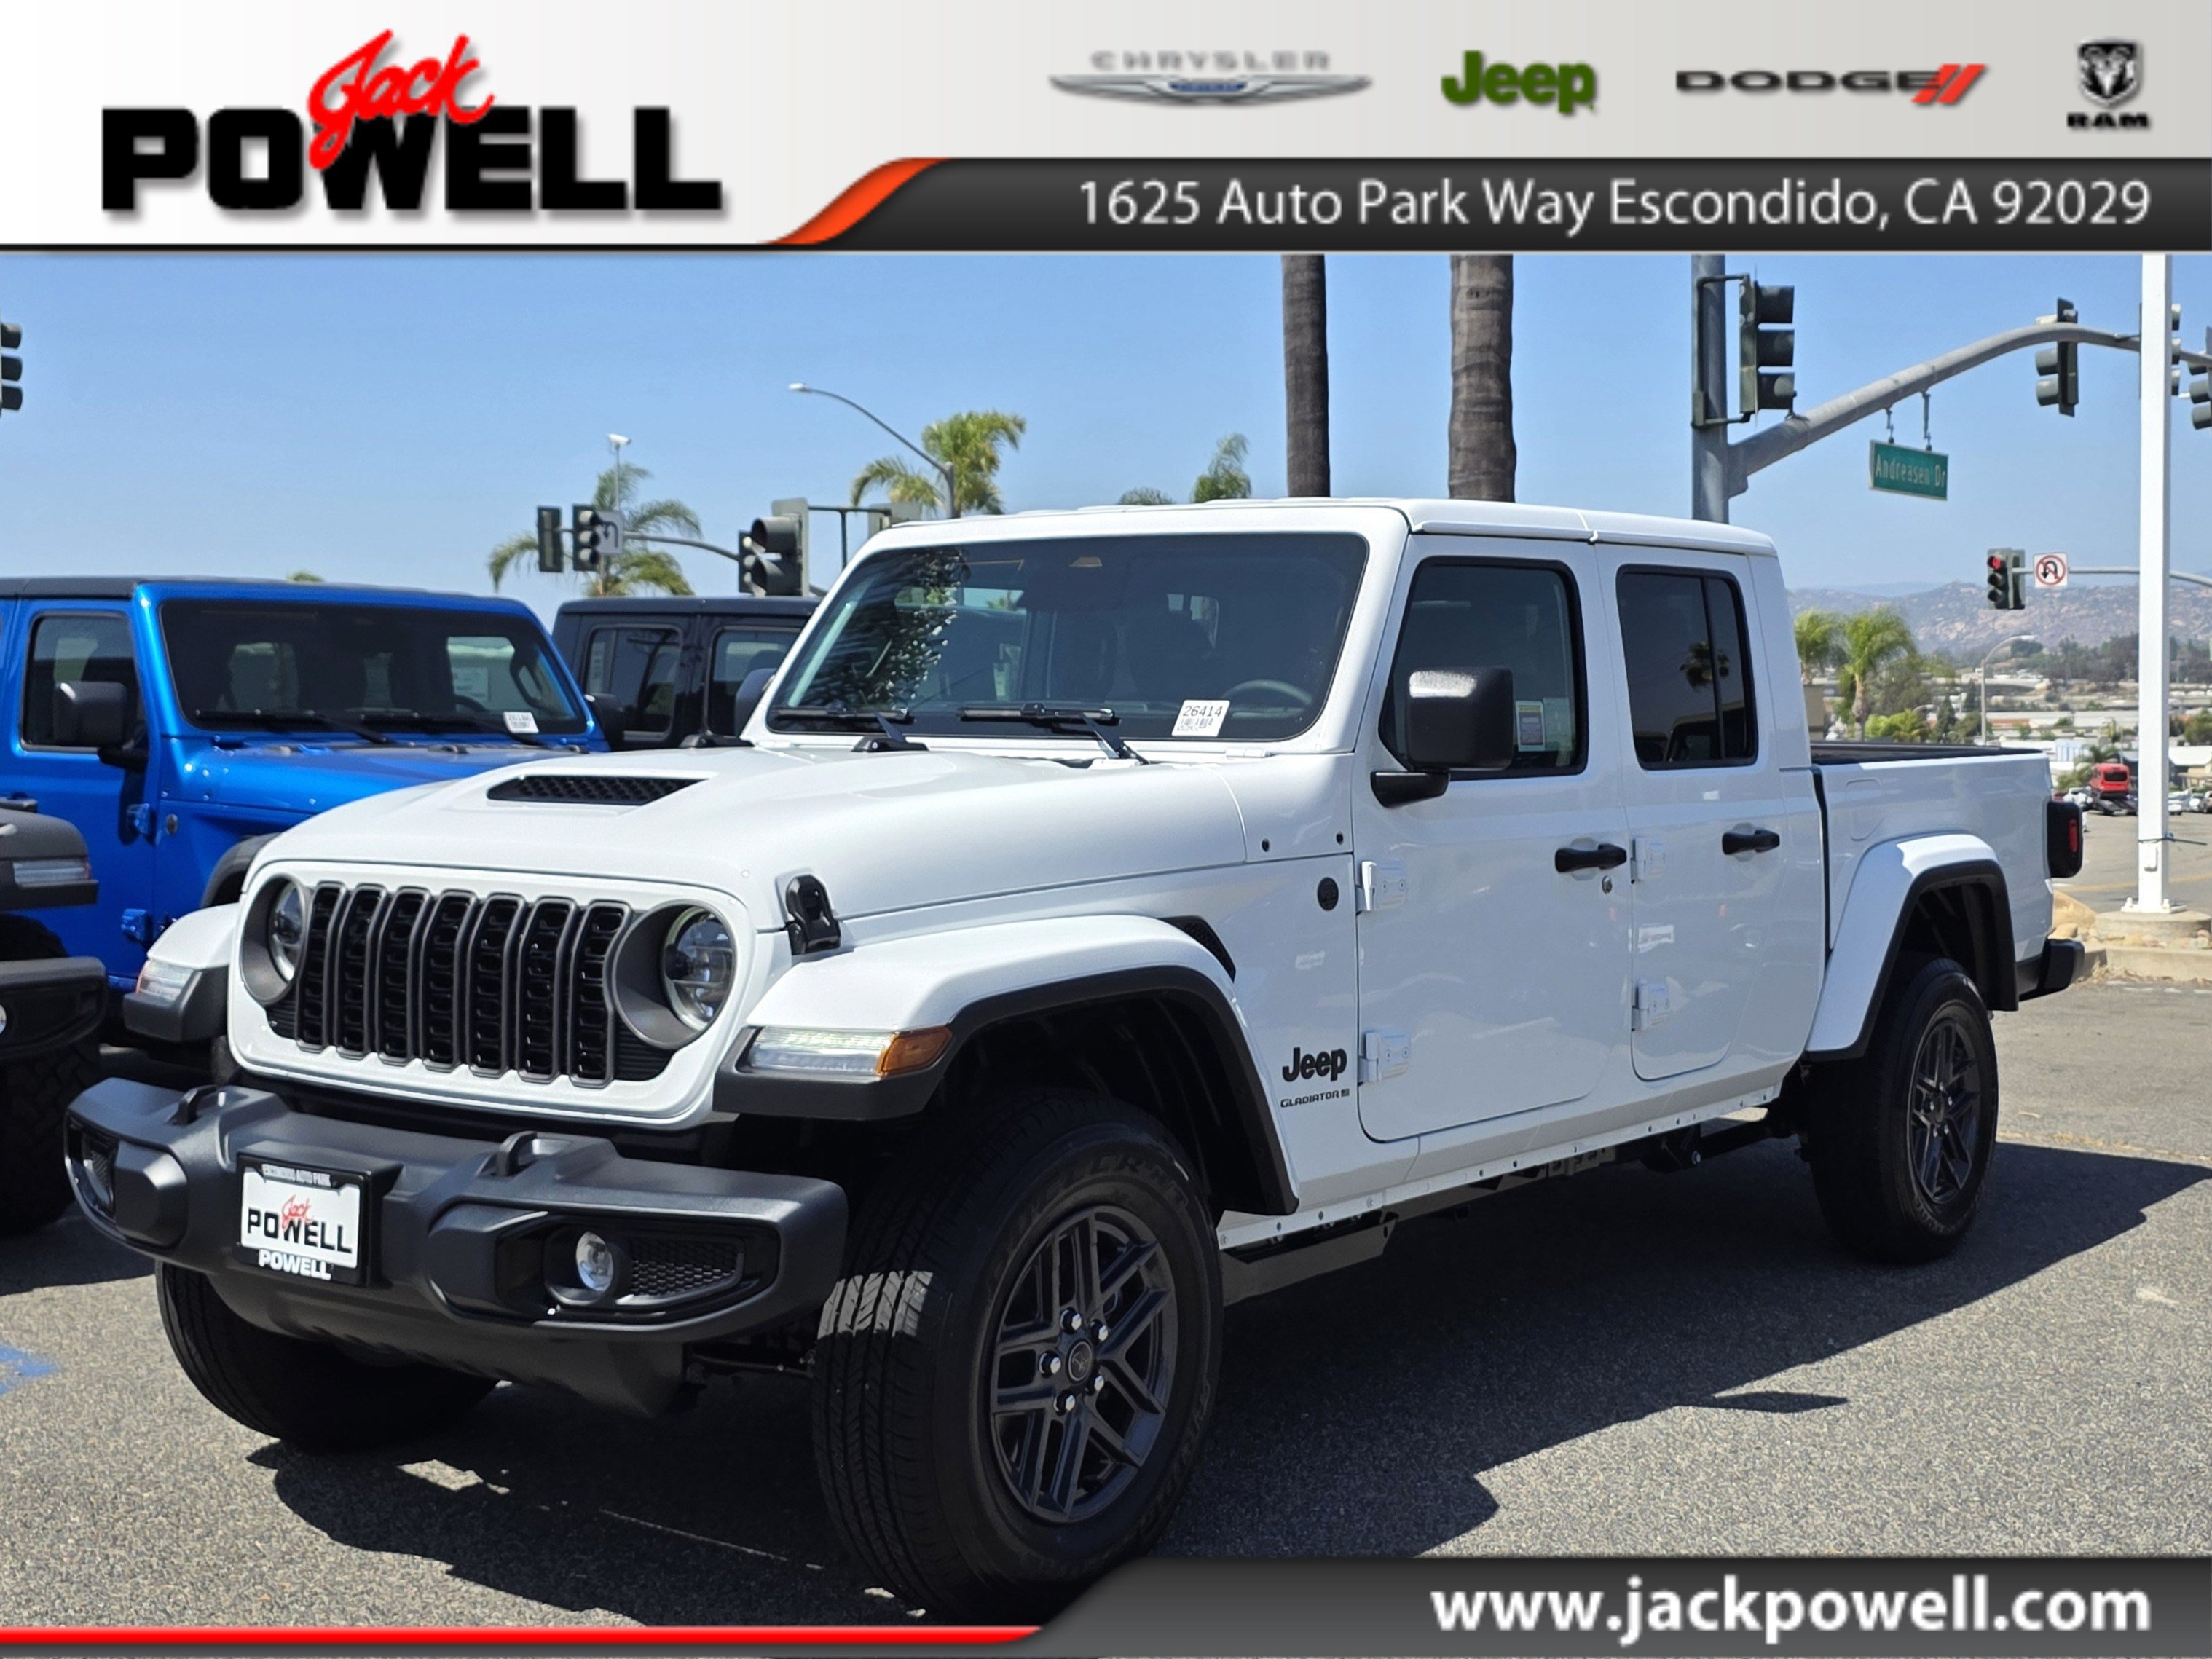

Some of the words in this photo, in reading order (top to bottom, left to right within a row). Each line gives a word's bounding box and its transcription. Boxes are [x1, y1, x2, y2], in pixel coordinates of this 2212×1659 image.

[1876, 454, 1930, 485] Andreasen
[1934, 464, 1945, 488] Dr
[1182, 705, 1224, 717] 26414
[1282, 1047, 1347, 1082] Jeep
[1280, 1090, 1339, 1108] GLADIATOR
[281, 1194, 312, 1230] Jack
[247, 1207, 353, 1254] POWELL
[258, 1248, 331, 1281] POWELL
